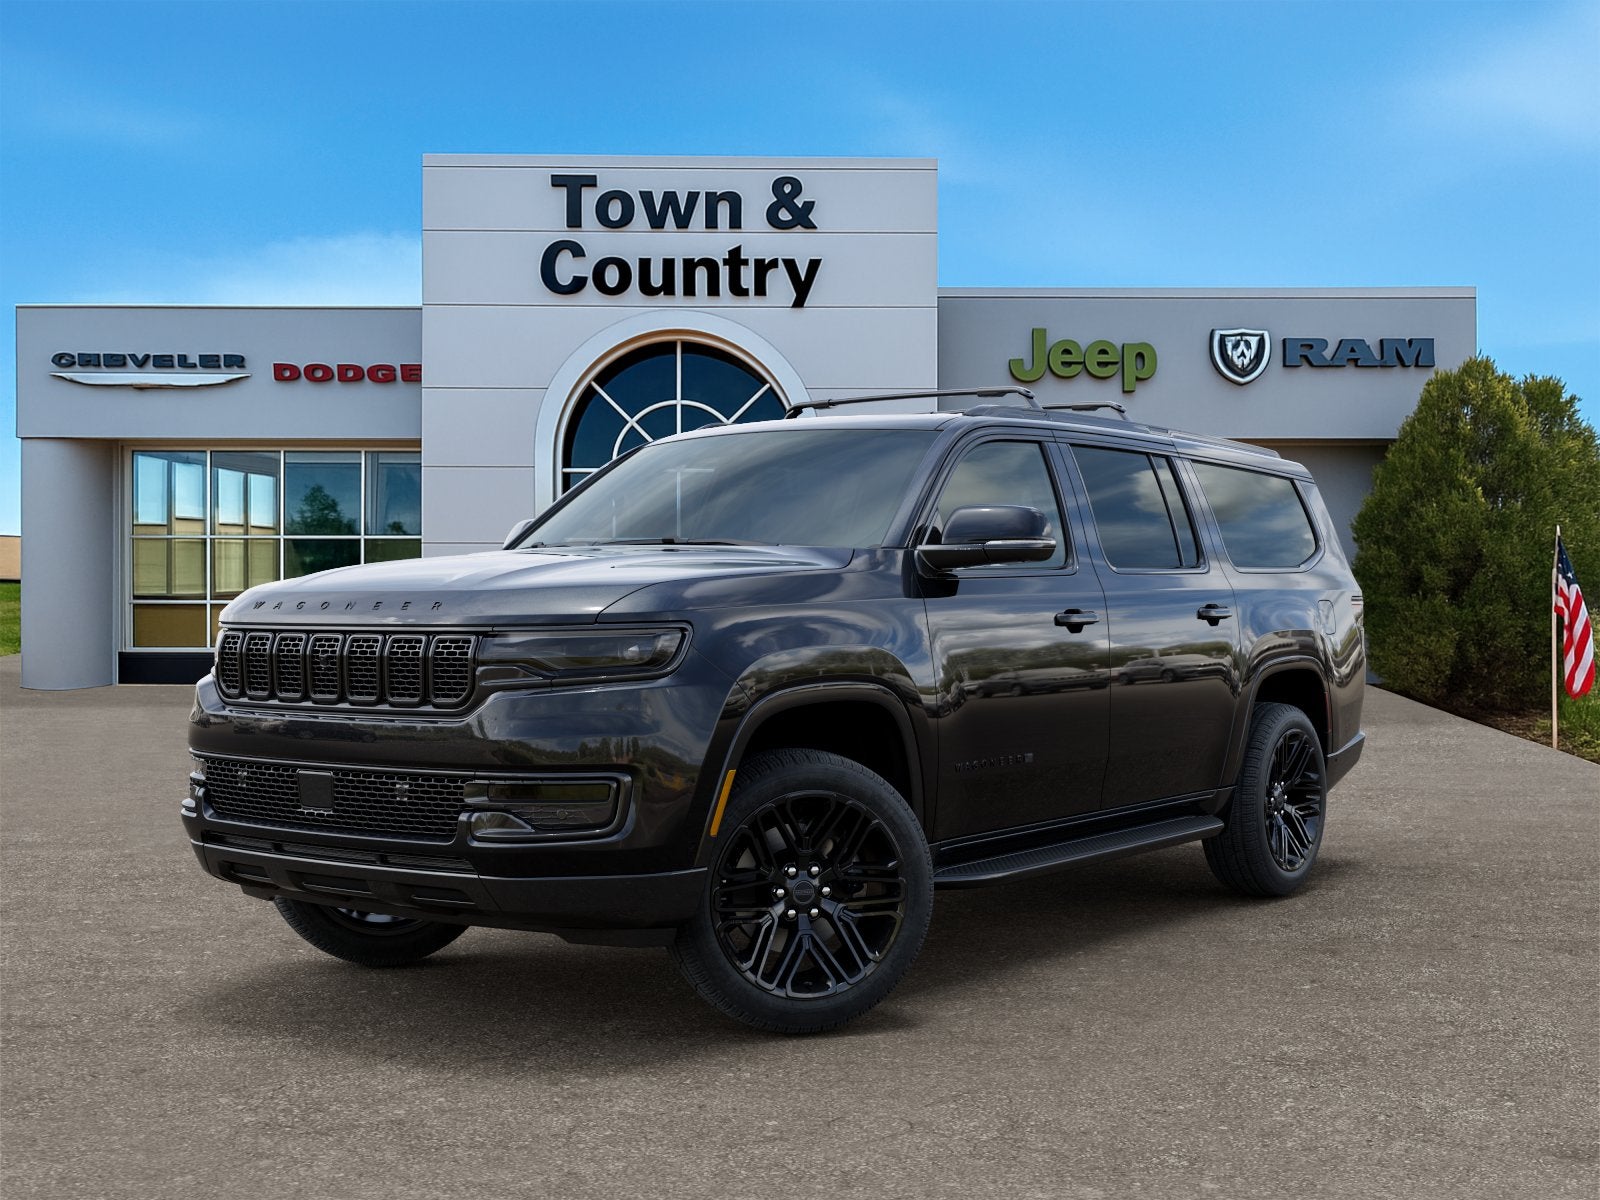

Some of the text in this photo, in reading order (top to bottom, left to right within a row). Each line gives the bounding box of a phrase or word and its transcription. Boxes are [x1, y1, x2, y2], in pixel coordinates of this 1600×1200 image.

[550, 174, 818, 230] Town &
[540, 239, 823, 308] Country
[273, 362, 422, 383] DODGE
[1009, 327, 1158, 393] Jeep
[1282, 337, 1436, 368] RAM
[253, 600, 443, 612] WAGONEER
